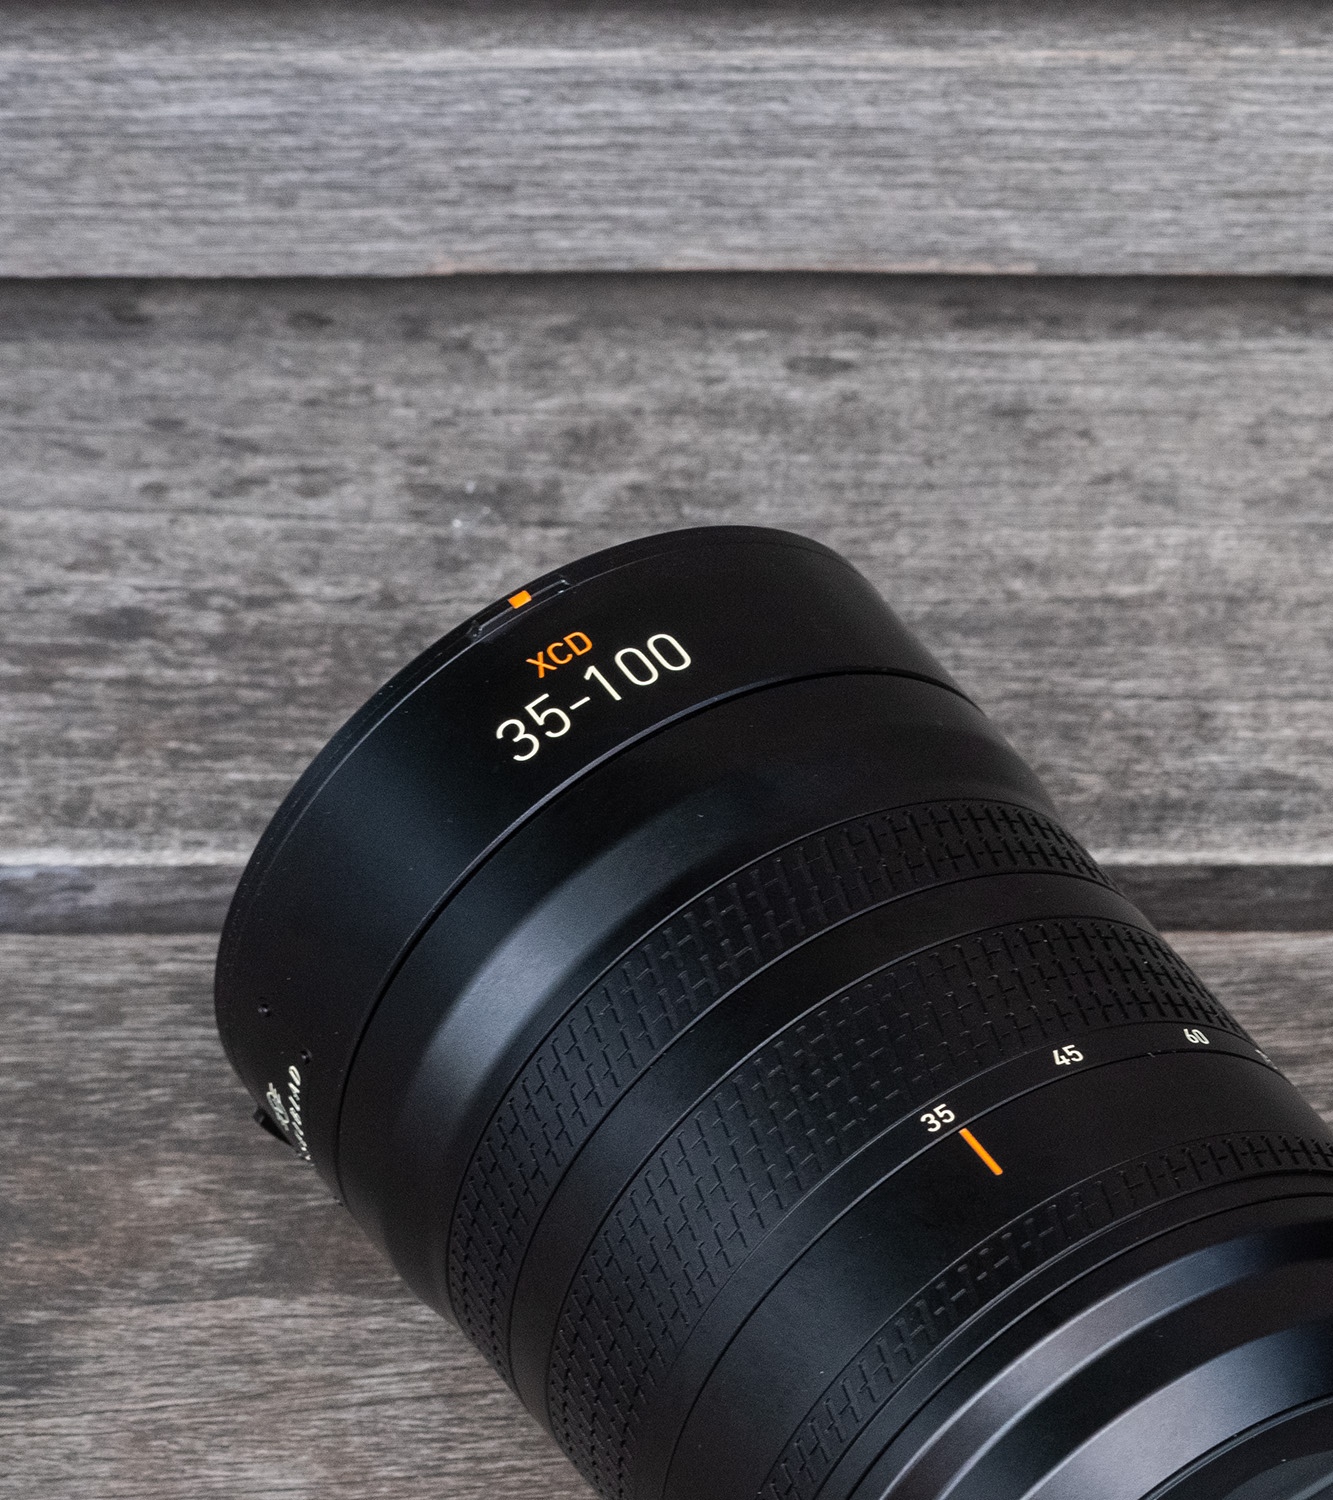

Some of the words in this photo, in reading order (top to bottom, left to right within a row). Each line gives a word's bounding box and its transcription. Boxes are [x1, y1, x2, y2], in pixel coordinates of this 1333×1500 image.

[495, 632, 692, 762] 35-100
[525, 630, 593, 678] XCD
[920, 1103, 956, 1133] 35
[1053, 1044, 1084, 1067] 45
[1183, 1028, 1210, 1046] 60
